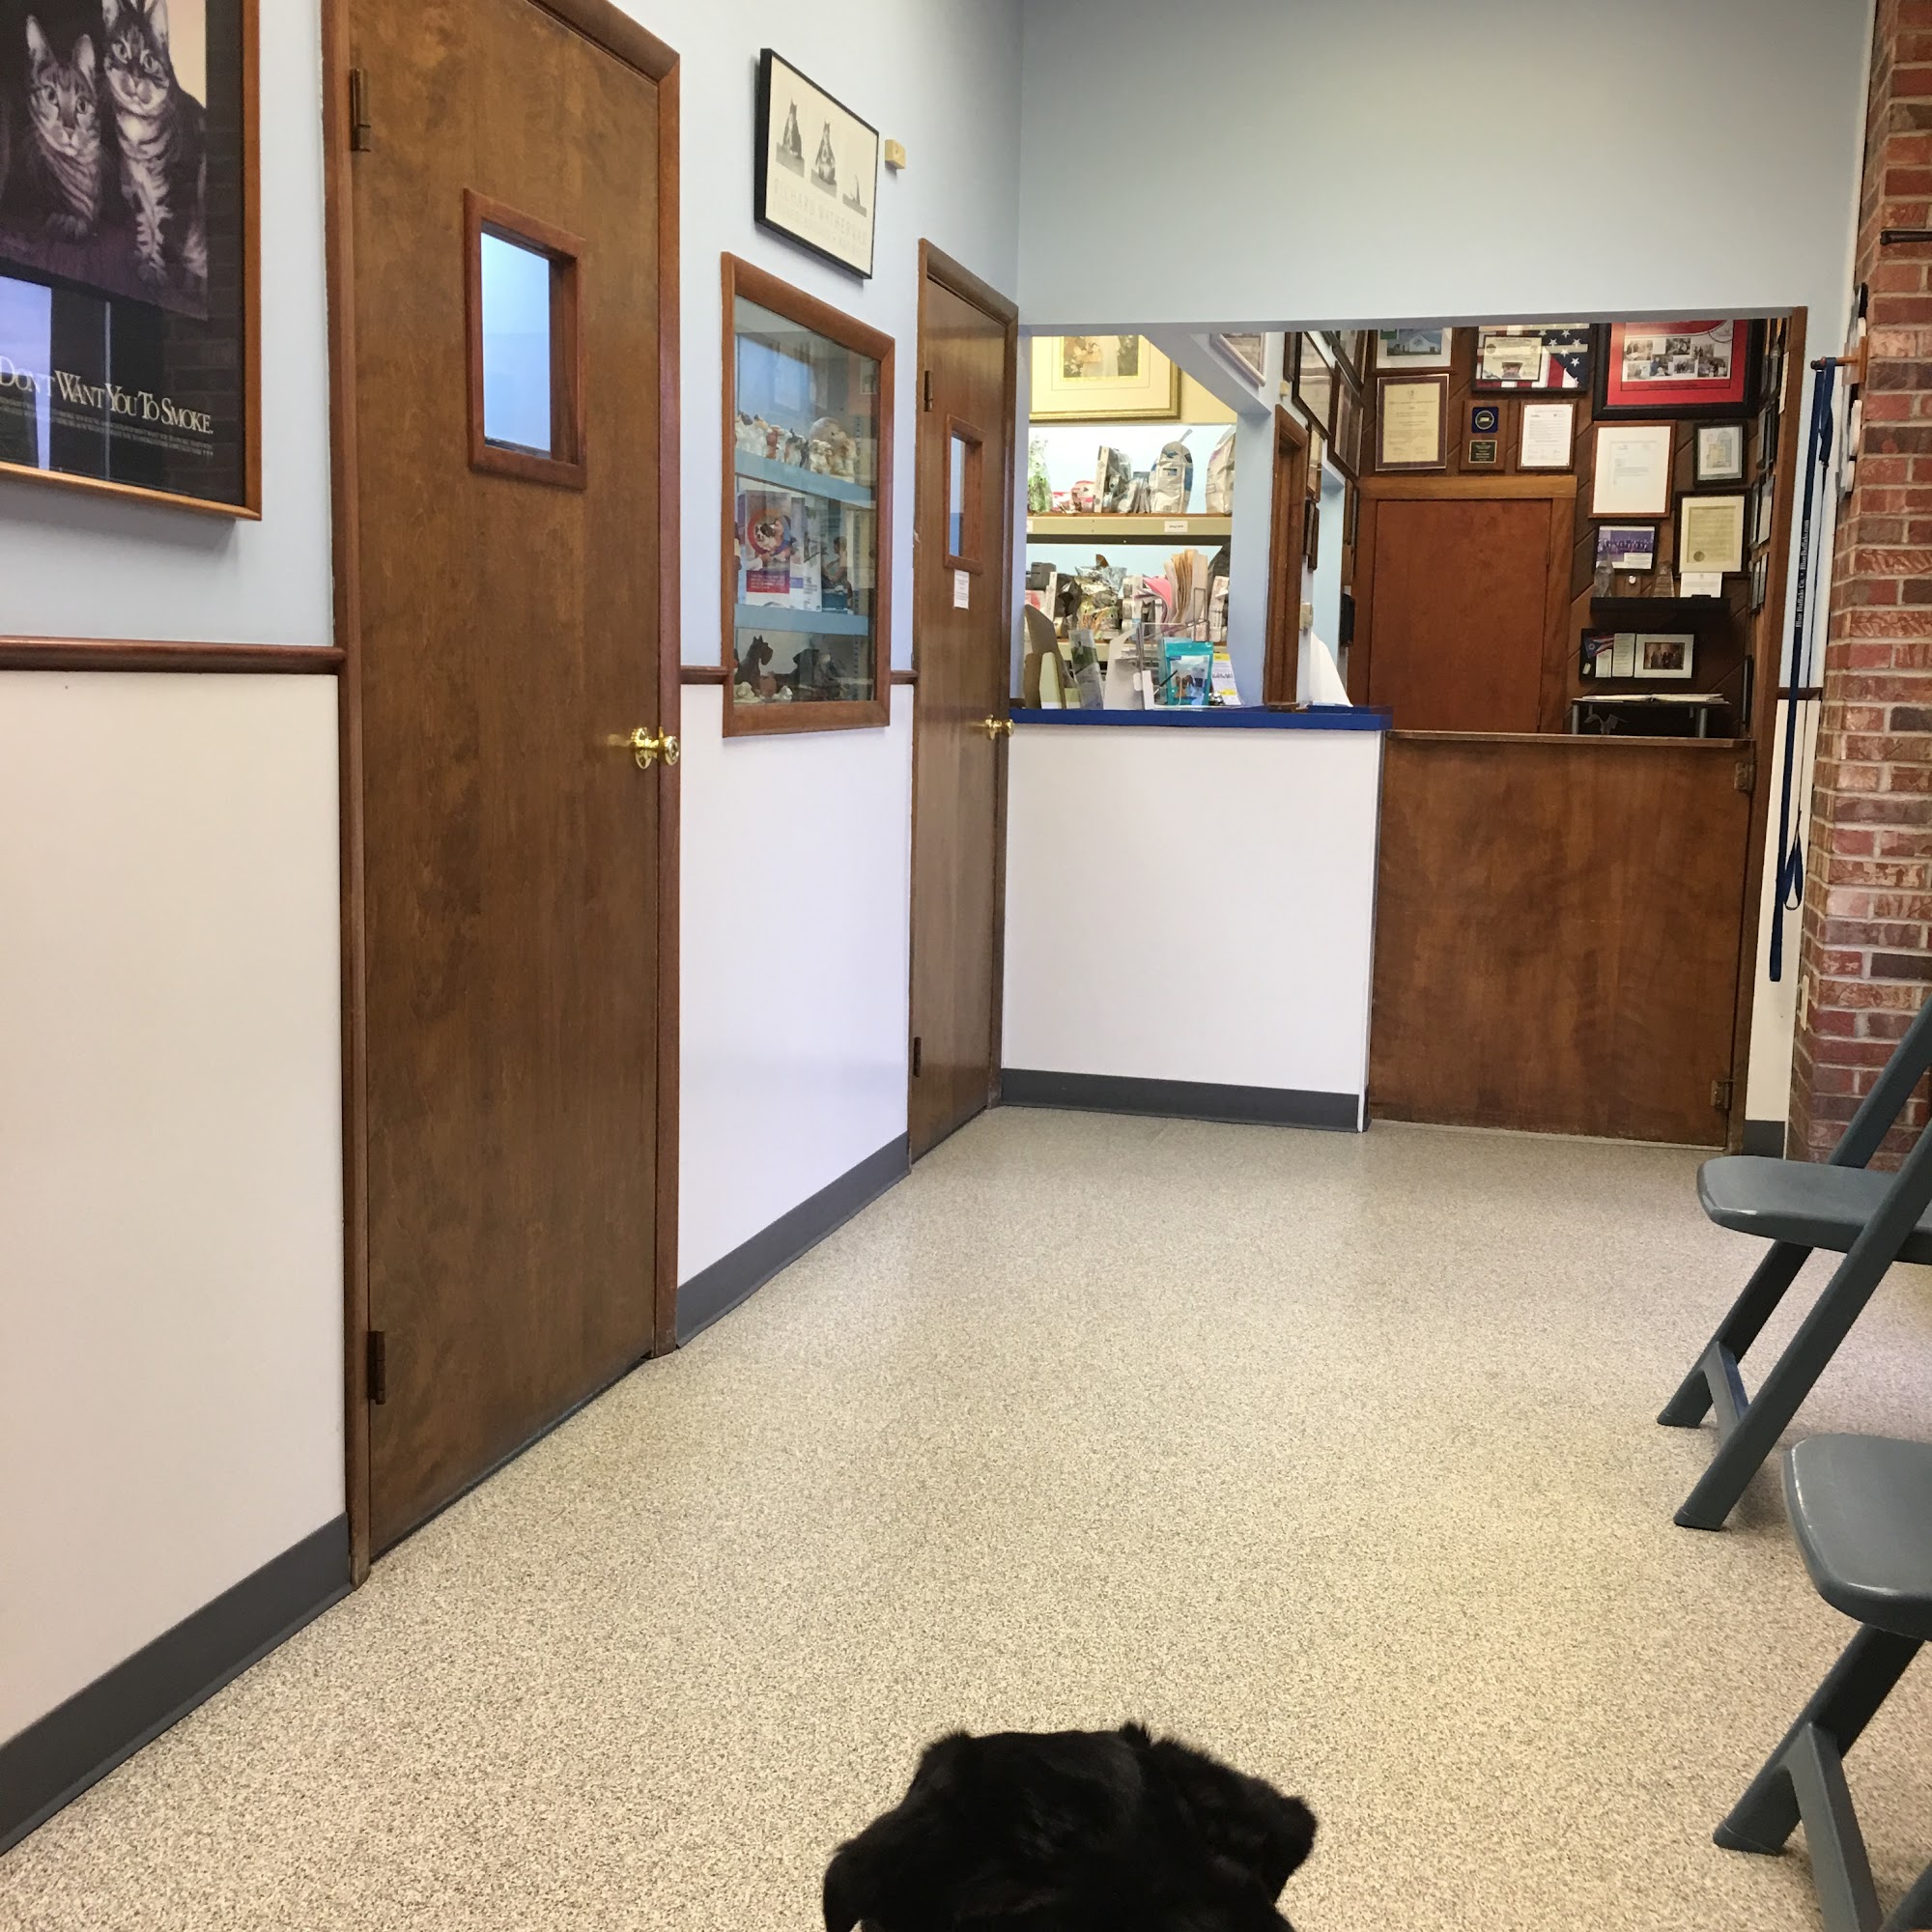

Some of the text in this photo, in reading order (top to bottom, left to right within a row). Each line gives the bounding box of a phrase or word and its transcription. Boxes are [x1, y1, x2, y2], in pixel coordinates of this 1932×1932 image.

[54, 370, 105, 409] WANT
[104, 383, 138, 416] YOU
[137, 391, 159, 421] TO
